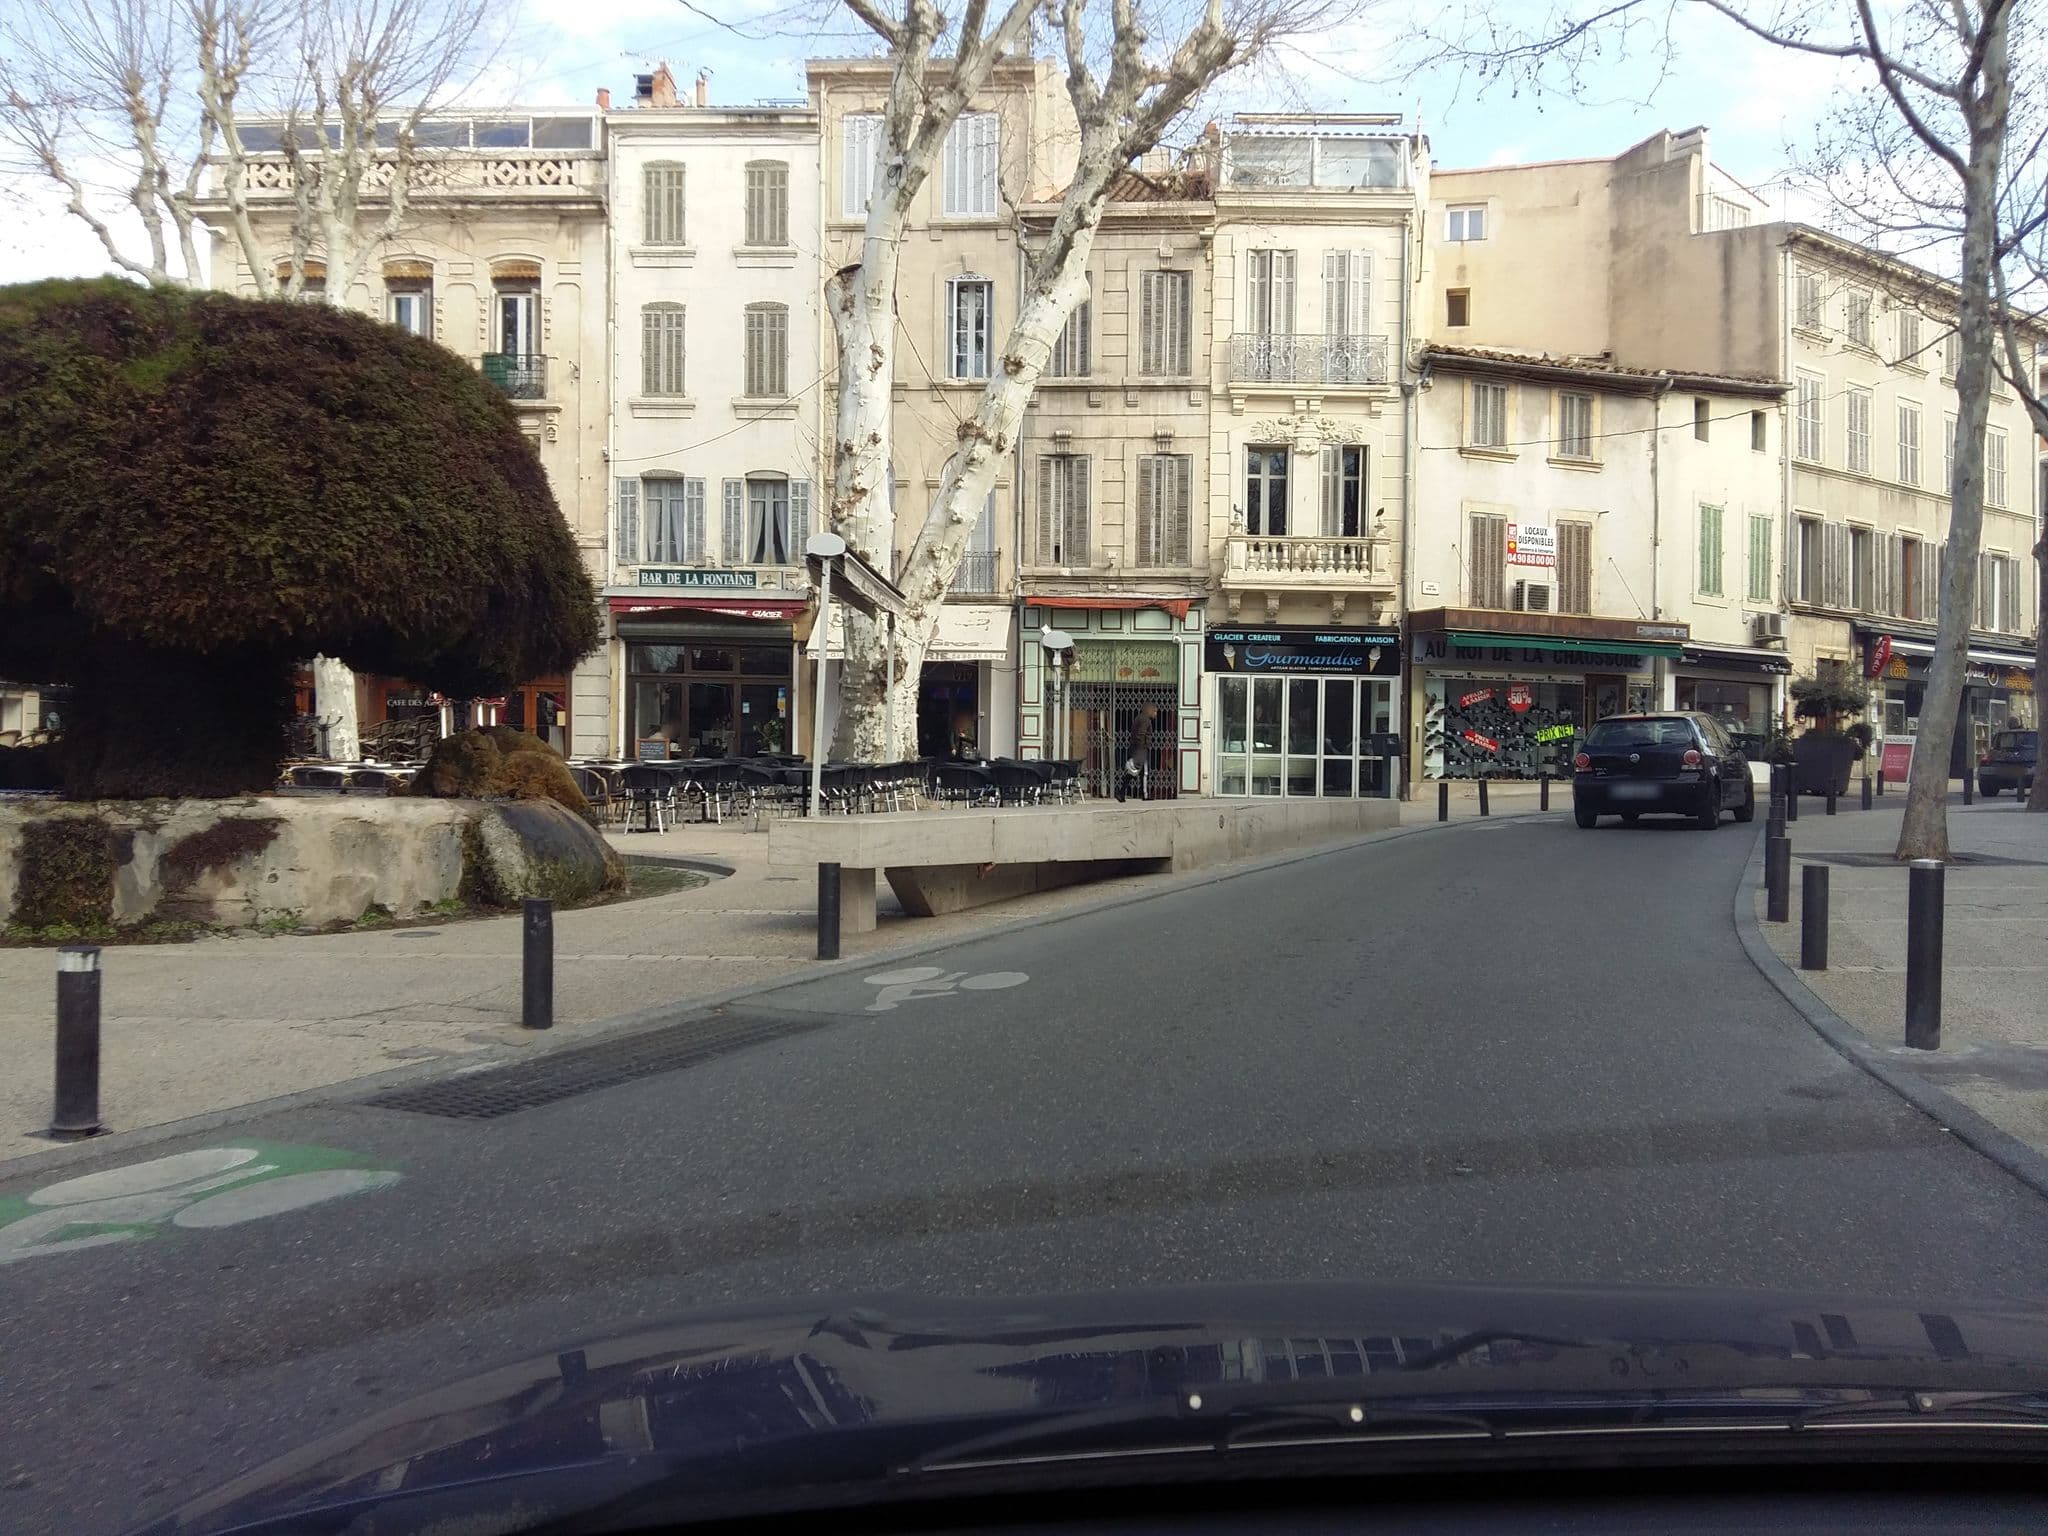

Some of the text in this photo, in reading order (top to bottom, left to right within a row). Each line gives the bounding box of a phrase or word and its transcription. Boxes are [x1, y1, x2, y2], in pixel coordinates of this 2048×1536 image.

[1524, 526, 1548, 536] LOCAUX
[1518, 535, 1554, 547] DISPONIBLES
[641, 572, 754, 586] BAR DE LA FONTAINE
[1214, 633, 1244, 641] GLACIER
[1315, 635, 1361, 643] FABRICATION
[1365, 636, 1394, 644] MAISON
[1245, 644, 1363, 667] Gourmandise
[1425, 640, 1446, 658] AU
[1523, 648, 1543, 663] LA
[1872, 640, 1888, 672] TABAC
[408, 699, 422, 707] DES
[1507, 688, 1532, 705] -50%
[1539, 723, 1574, 740] PRIX NET
